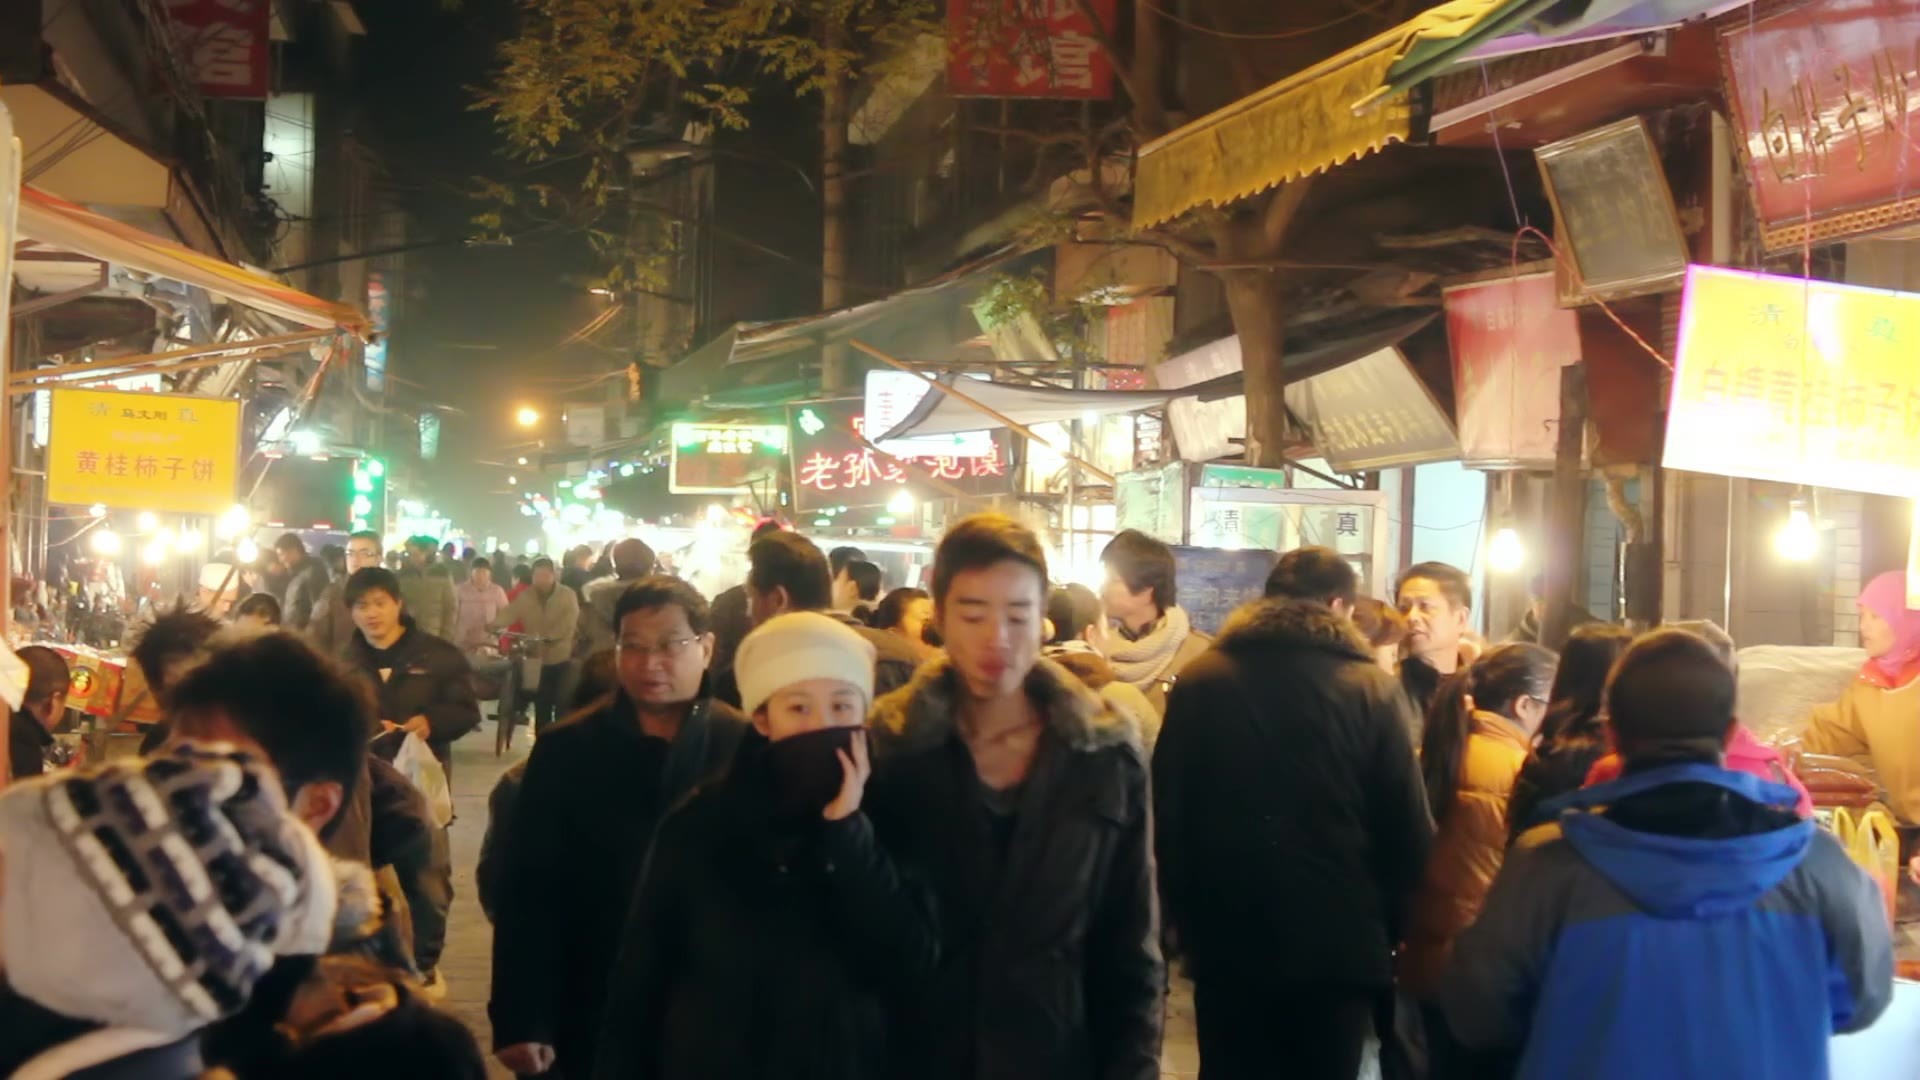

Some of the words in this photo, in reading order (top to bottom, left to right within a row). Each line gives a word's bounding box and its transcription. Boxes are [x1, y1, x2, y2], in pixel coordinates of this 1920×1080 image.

[75, 450, 215, 482] 黄桂柿子饼
[1214, 508, 1240, 533] 清
[1335, 511, 1360, 537] 真
